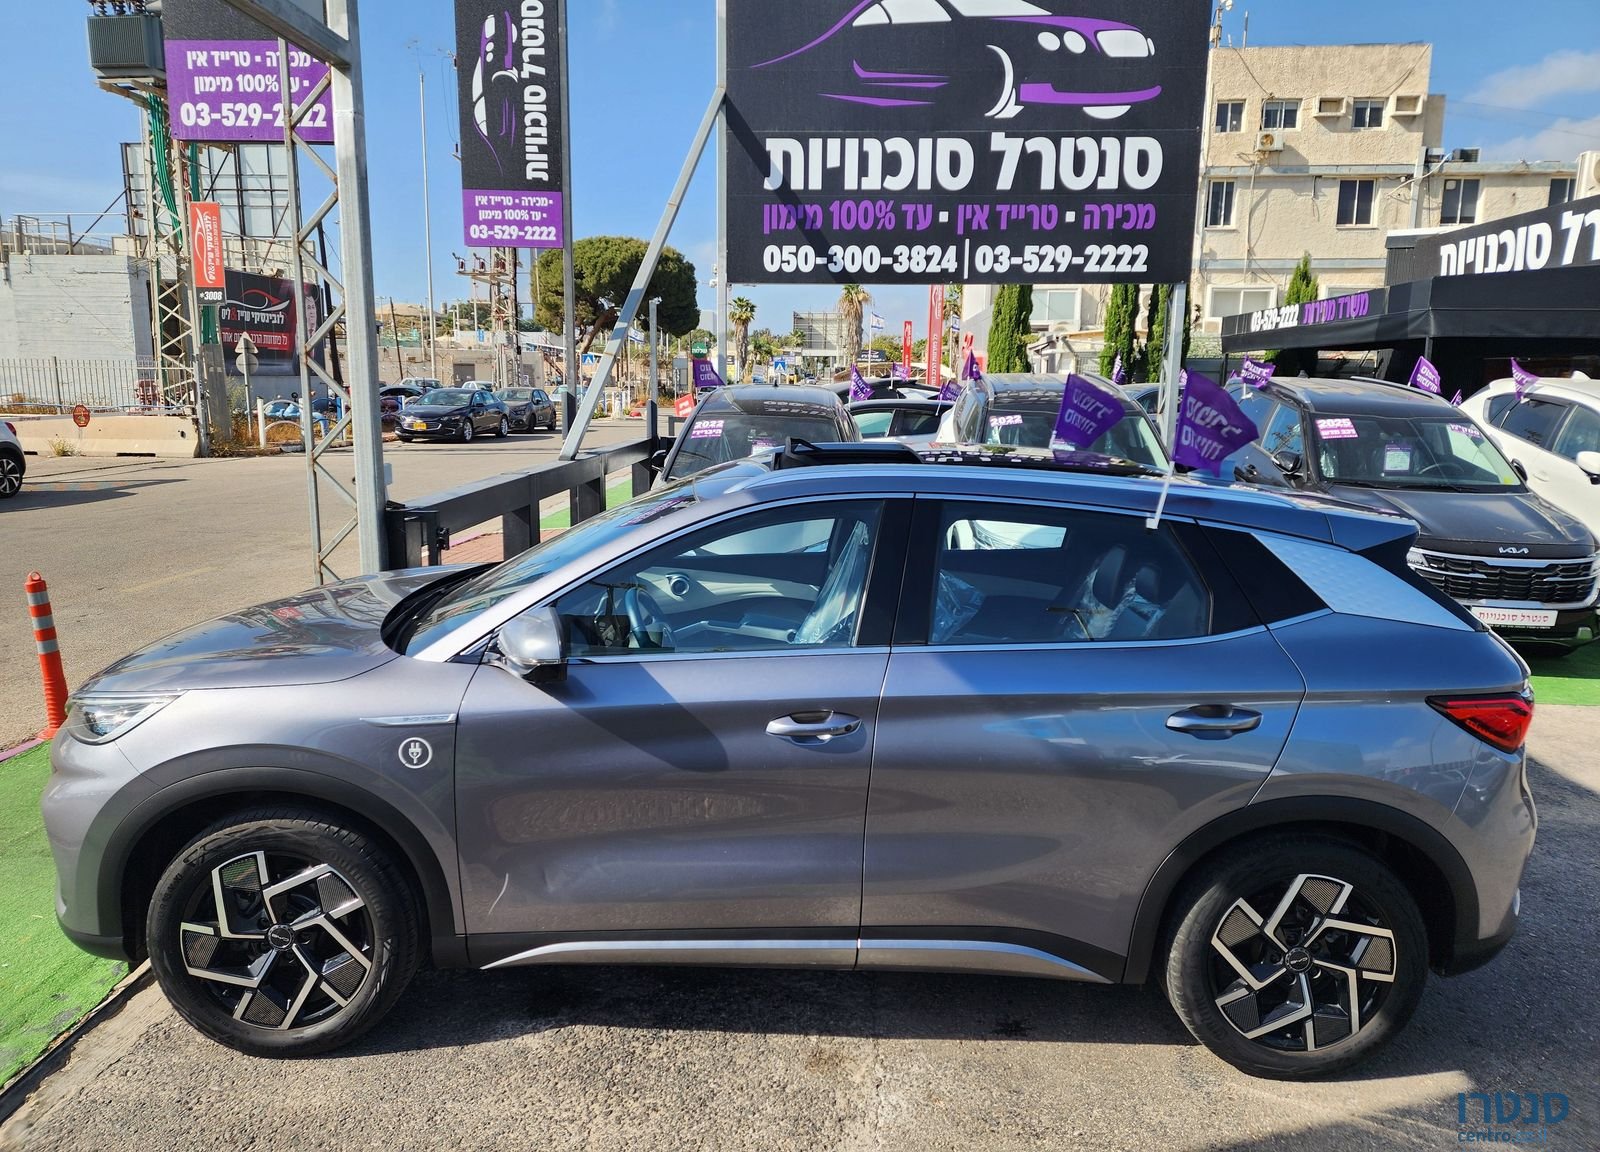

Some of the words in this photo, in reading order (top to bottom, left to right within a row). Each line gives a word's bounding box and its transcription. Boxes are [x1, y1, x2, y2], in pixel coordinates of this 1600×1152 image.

[187, 51, 208, 69] אין
[210, 51, 250, 66] טרייד
[194, 76, 233, 94] מימון
[236, 74, 280, 92] 100%
[524, 84, 549, 182] סוכנויות
[764, 136, 974, 191] סוכנויות
[990, 132, 1164, 190] סנטרל
[474, 196, 488, 206] אין
[489, 196, 513, 206] טרייד
[521, 196, 548, 206] מכירה
[479, 210, 502, 221] מימון
[504, 209, 529, 220] 100%
[530, 210, 542, 220] עד
[764, 204, 822, 234] מימון
[830, 200, 896, 231] 100%
[902, 204, 933, 231] עד
[957, 204, 988, 235] אין
[996, 204, 1057, 230] טרייד
[1084, 202, 1156, 230] מכירה
[470, 224, 556, 240] 03-529-2222
[1440, 222, 1552, 276] סוכנויות
[764, 244, 958, 273] 050-300-3824
[974, 244, 1148, 273] 03-529-2222
[1338, 292, 1369, 319] משרד
[1250, 304, 1300, 332] 03-529-2222
[694, 420, 724, 430] 2022
[990, 415, 1022, 427] 2022
[1317, 418, 1352, 428] 2025
[1478, 611, 1518, 622] סוכנויות
[1520, 613, 1550, 623] סנטרל
